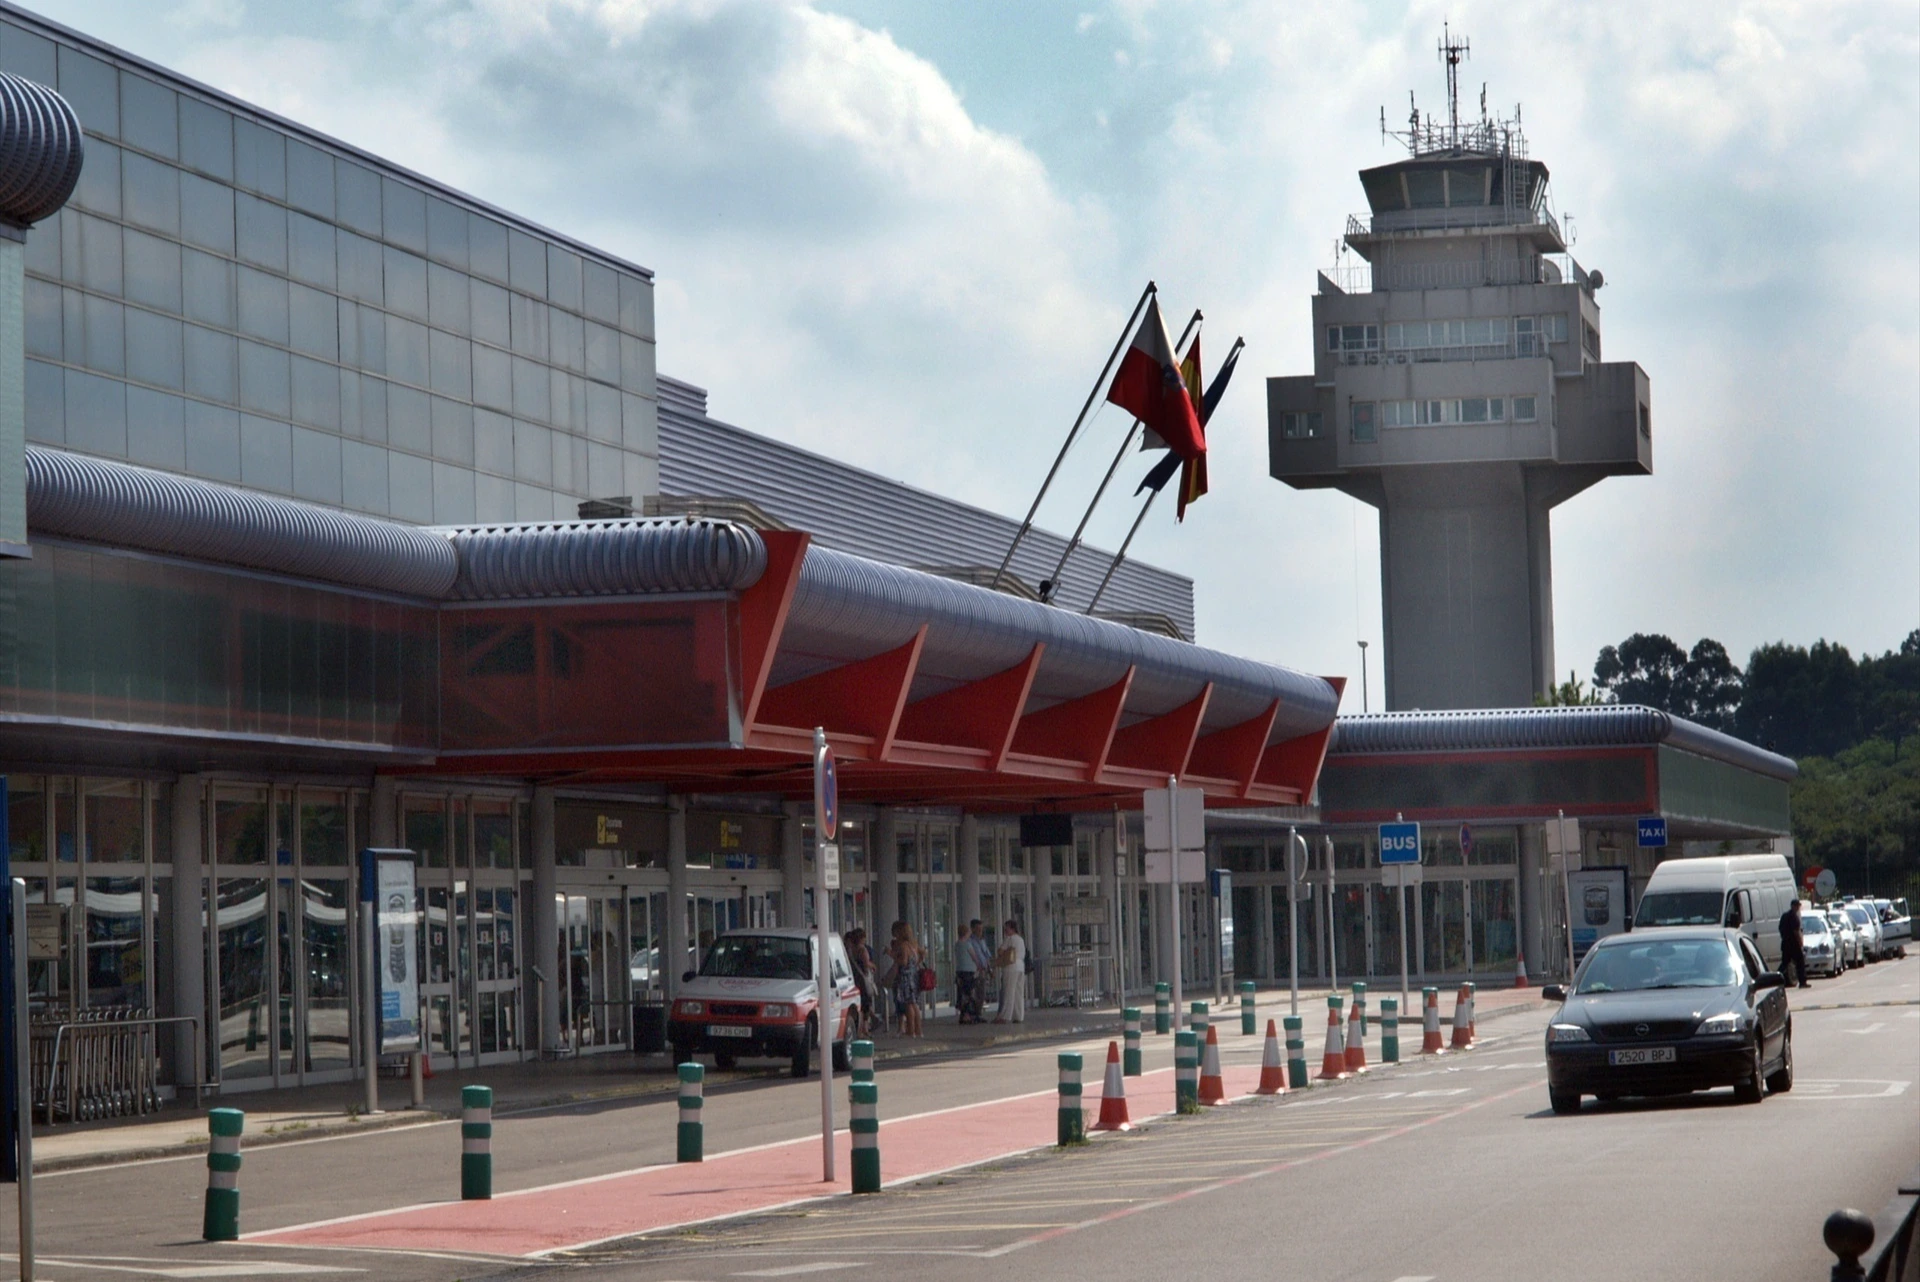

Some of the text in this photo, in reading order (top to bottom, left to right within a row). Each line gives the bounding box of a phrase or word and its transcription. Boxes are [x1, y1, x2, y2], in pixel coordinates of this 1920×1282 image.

[1640, 828, 1665, 837] TAXI
[1382, 836, 1416, 850] BUS
[1618, 1049, 1672, 1063] 2520 BPJ
